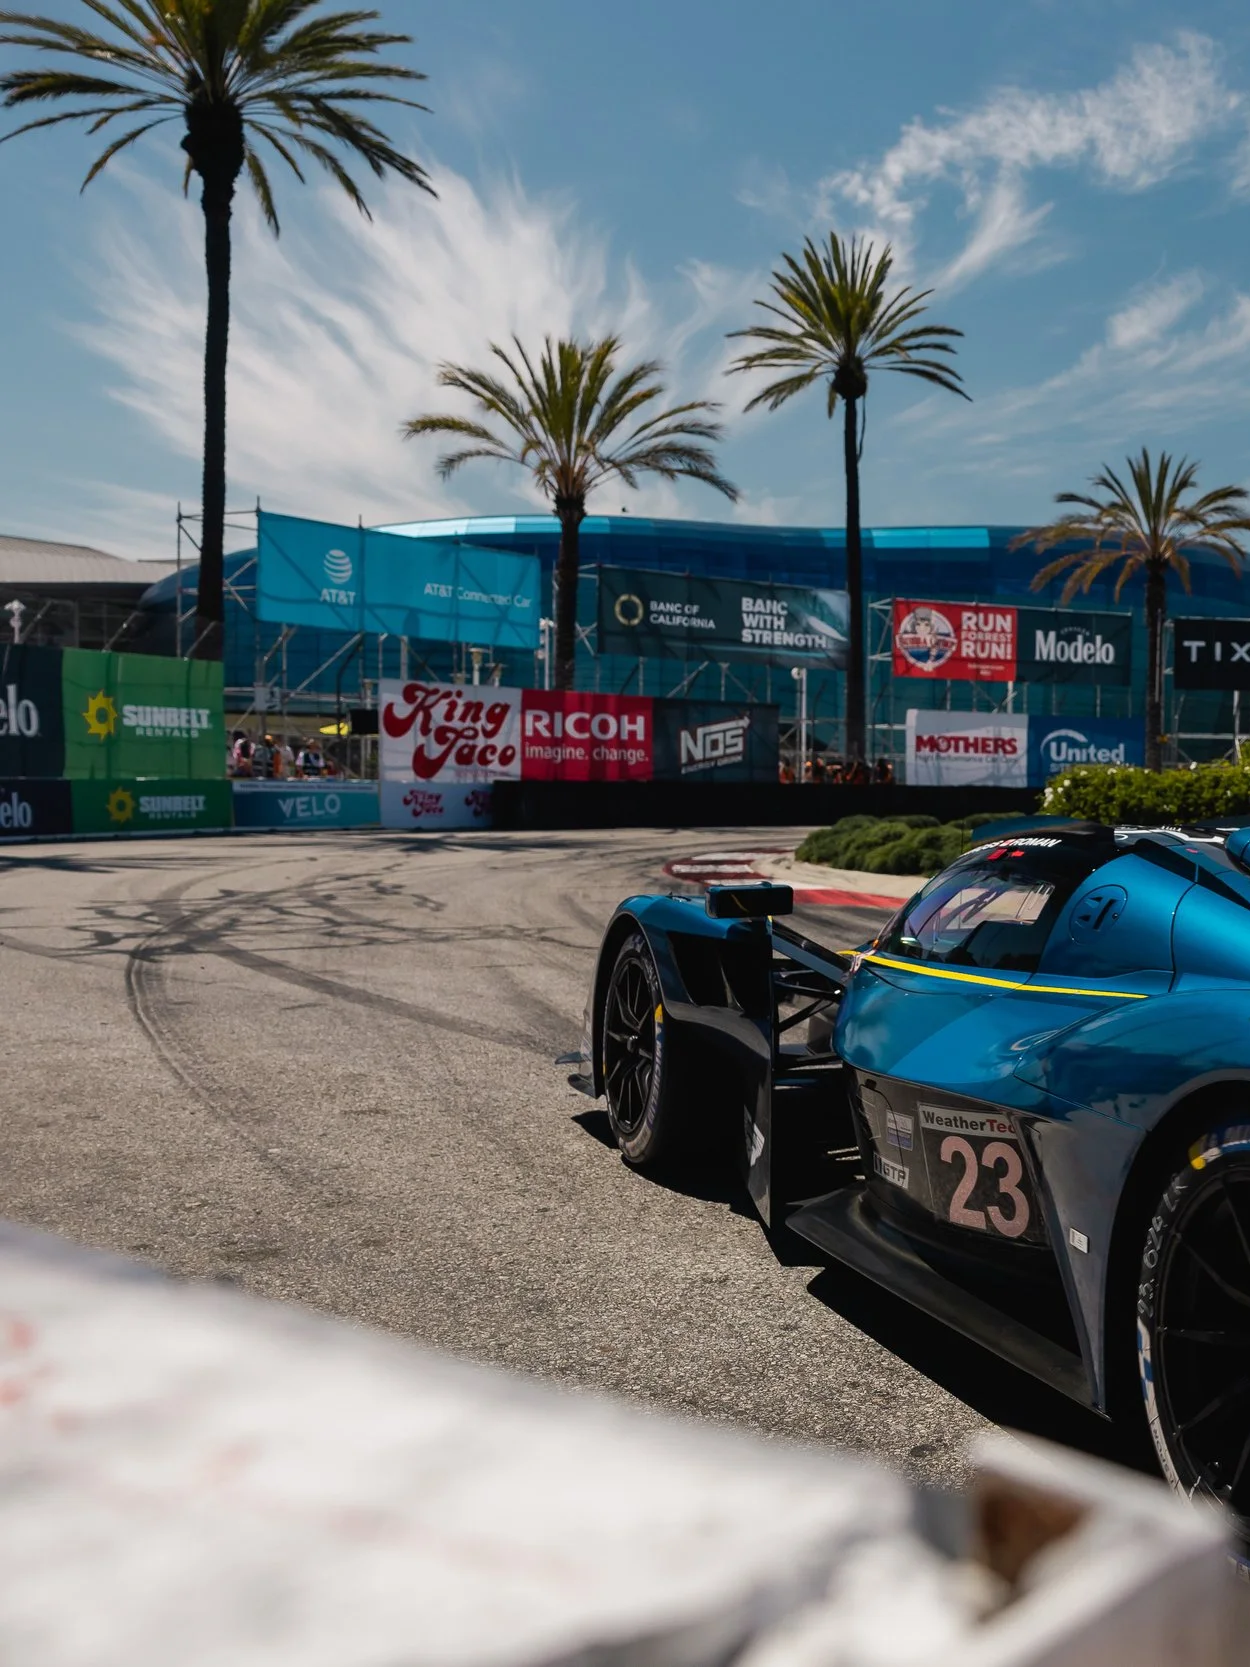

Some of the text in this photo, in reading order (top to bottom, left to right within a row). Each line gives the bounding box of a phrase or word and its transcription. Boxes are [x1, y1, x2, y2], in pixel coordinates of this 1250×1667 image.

[320, 588, 356, 605] AT&T
[424, 582, 453, 597] AT&T
[514, 594, 532, 607] Car
[650, 600, 700, 614] BANC OF
[741, 597, 788, 615] BANC
[650, 614, 715, 629] CALIFORNIA
[742, 613, 785, 630] WITH
[961, 611, 1012, 632] RUN
[961, 631, 1012, 642] FORREST
[1034, 629, 1115, 665] Modelo
[961, 641, 1012, 660] RUN!
[122, 704, 210, 729] SUNBELT
[383, 683, 511, 739] King
[136, 727, 199, 738] RENTALS
[525, 709, 645, 741] RICOH
[412, 725, 516, 779] Taco
[525, 742, 649, 765] imagine. change.
[680, 722, 746, 764] NOS
[915, 735, 1018, 754] MOTHERS
[1050, 741, 1124, 762] United
[139, 795, 205, 812] SUNBELT
[278, 794, 341, 818] VELO
[1010, 838, 1062, 848] ROMAN
[647, 1040, 664, 1126] MICHELIN
[923, 1110, 1017, 1133] WeatherTec
[883, 1164, 906, 1184] GTP
[941, 1136, 1030, 1237] 23
